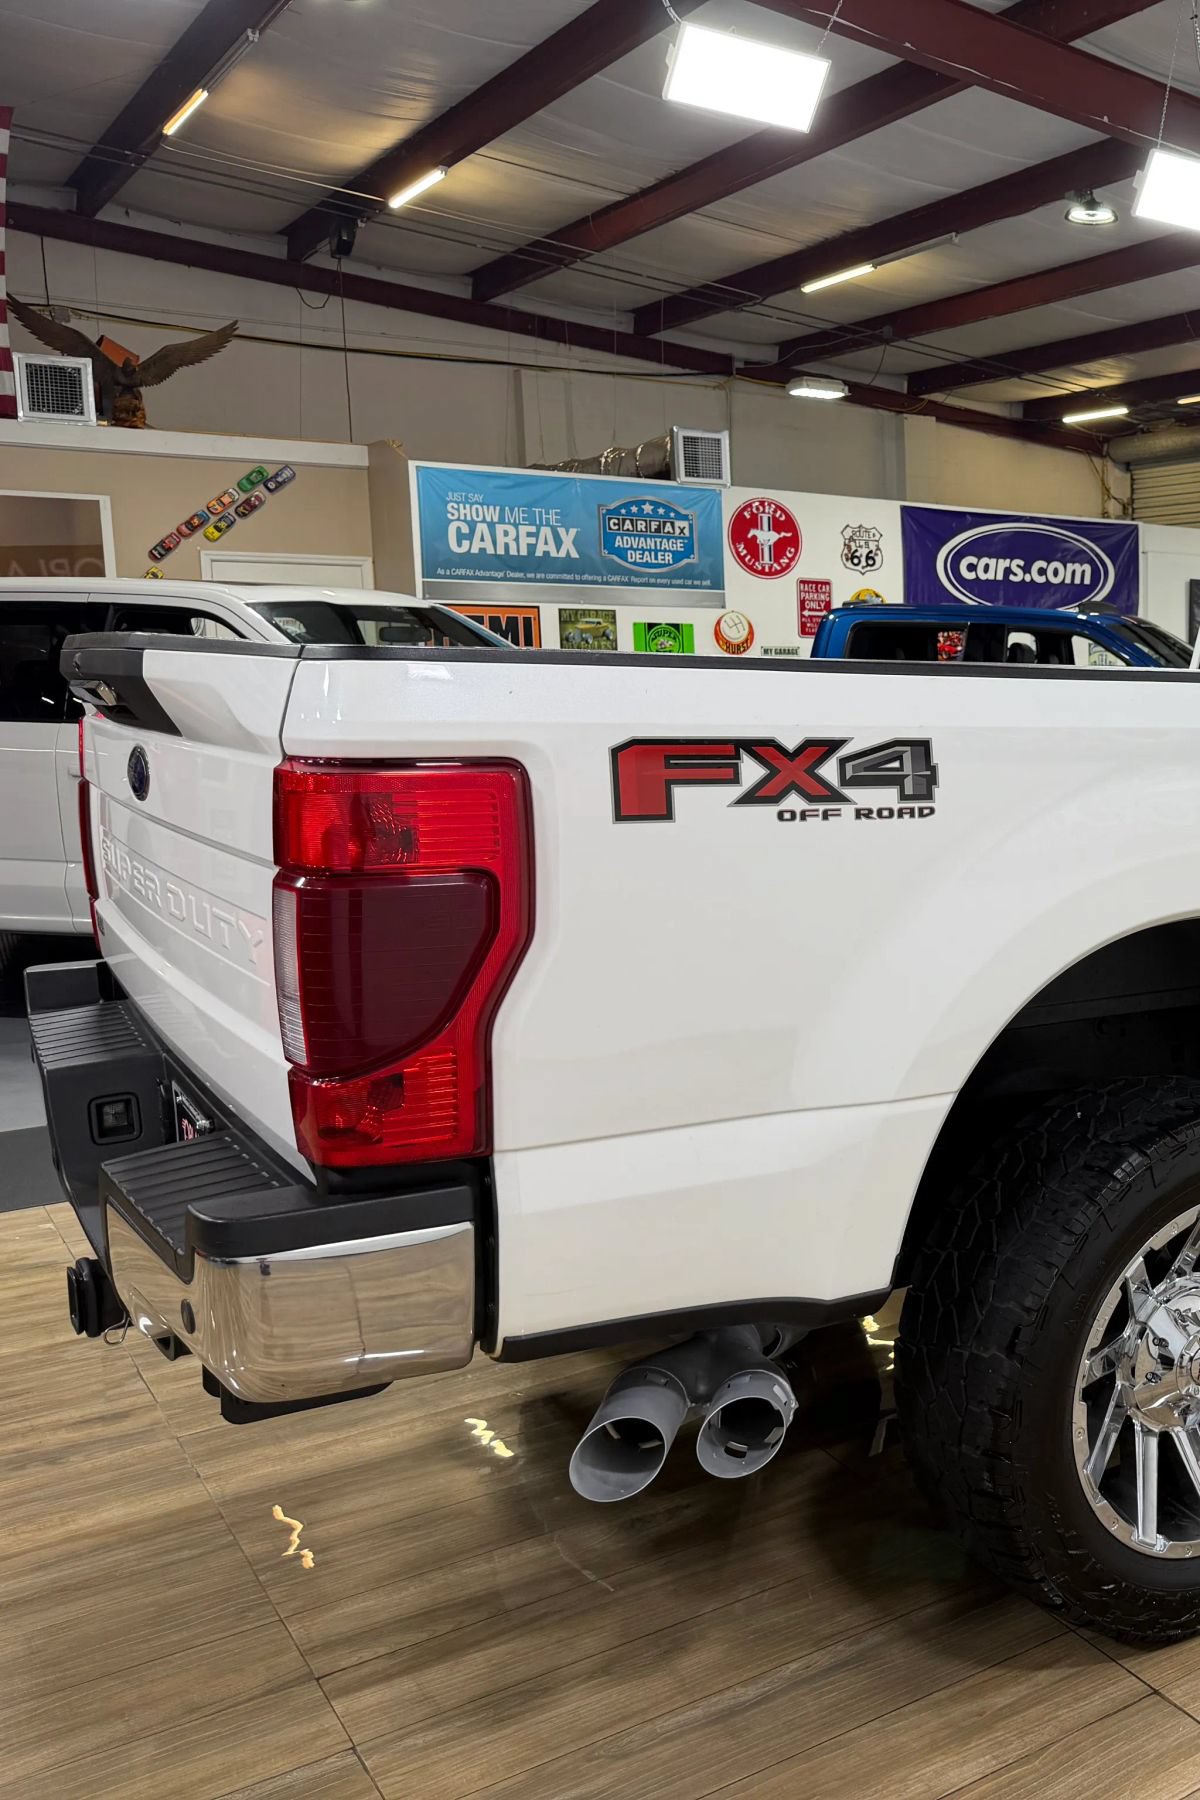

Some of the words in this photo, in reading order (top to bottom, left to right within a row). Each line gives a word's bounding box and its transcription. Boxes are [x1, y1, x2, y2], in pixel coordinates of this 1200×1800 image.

[446, 492, 466, 502] JUST
[467, 493, 484, 503] SAY
[446, 503, 500, 522] SHOW
[504, 506, 529, 525] ME
[532, 508, 562, 527] THE
[744, 501, 786, 521] FORD
[607, 516, 689, 537] CARFAX
[448, 522, 580, 559] CARFAX
[614, 535, 686, 552] ADVANTAGE
[627, 550, 674, 564] DEALER
[736, 541, 796, 573] MUSTANG
[851, 549, 876, 568] 66
[959, 555, 1092, 585] cars.com
[800, 583, 816, 592] RACE
[817, 584, 830, 593] CAR
[800, 592, 830, 601] PARKING
[805, 601, 826, 609] ONLY
[725, 640, 750, 655] HURST
[763, 648, 773, 656] MY
[774, 648, 799, 656] GARAGE
[608, 736, 939, 824] FX4
[777, 807, 843, 822] OFF
[854, 805, 937, 821] ROAD
[101, 836, 162, 909] SUPER
[167, 882, 265, 966] DUTY
